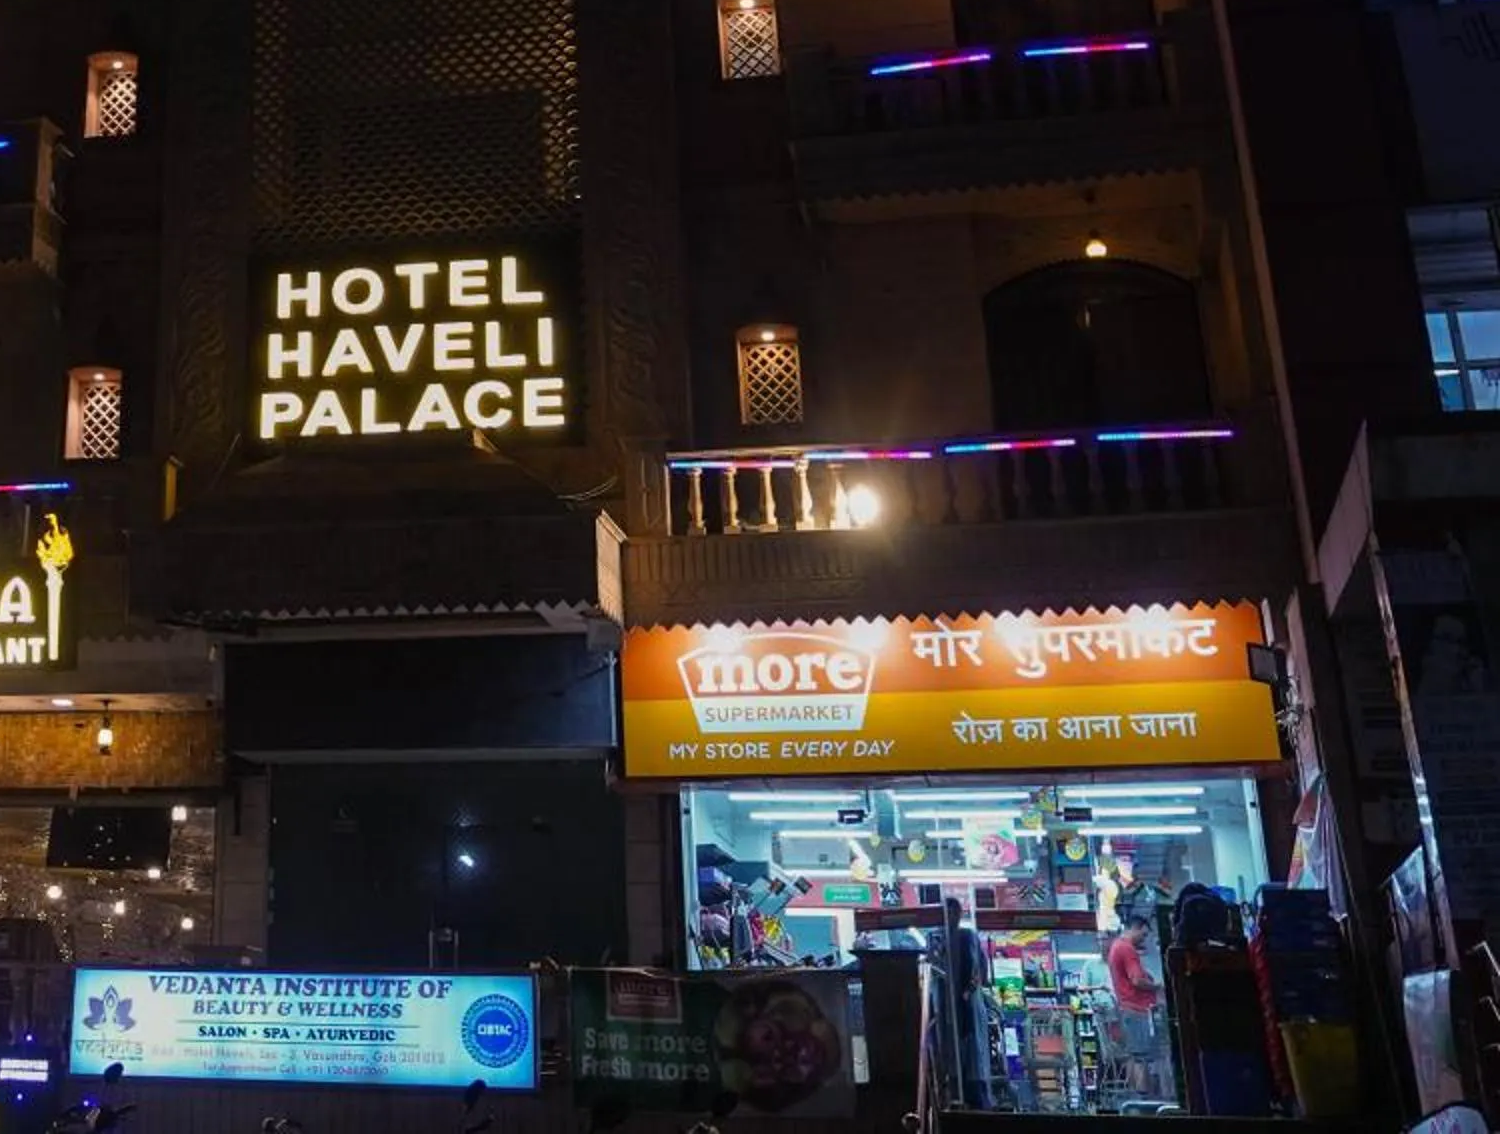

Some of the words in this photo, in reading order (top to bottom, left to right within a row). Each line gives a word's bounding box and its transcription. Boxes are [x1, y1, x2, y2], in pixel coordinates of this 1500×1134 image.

[276, 255, 545, 319] HOTEL
[267, 316, 554, 379] HAVELI
[260, 377, 566, 439] PALACE
[910, 617, 984, 667] मोर
[696, 649, 864, 693] more
[704, 704, 855, 724] SUPERMARKET
[1010, 717, 1049, 742] का
[1056, 715, 1122, 740] आना
[1128, 712, 1198, 738] जाना
[669, 743, 699, 760] MY
[704, 742, 771, 760] STORE
[779, 741, 849, 758] EVERY
[853, 739, 895, 758] DAY
[148, 975, 268, 996] VEDANTA
[273, 976, 412, 999] INSTITUTE
[417, 979, 453, 999] OF
[192, 999, 272, 1017] BEAUTY
[276, 999, 293, 1017] &
[299, 1000, 404, 1019] WELLNESS
[198, 1026, 247, 1039] SALON
[262, 1026, 291, 1040] SPA
[306, 1028, 397, 1042] AYURVEDIC
